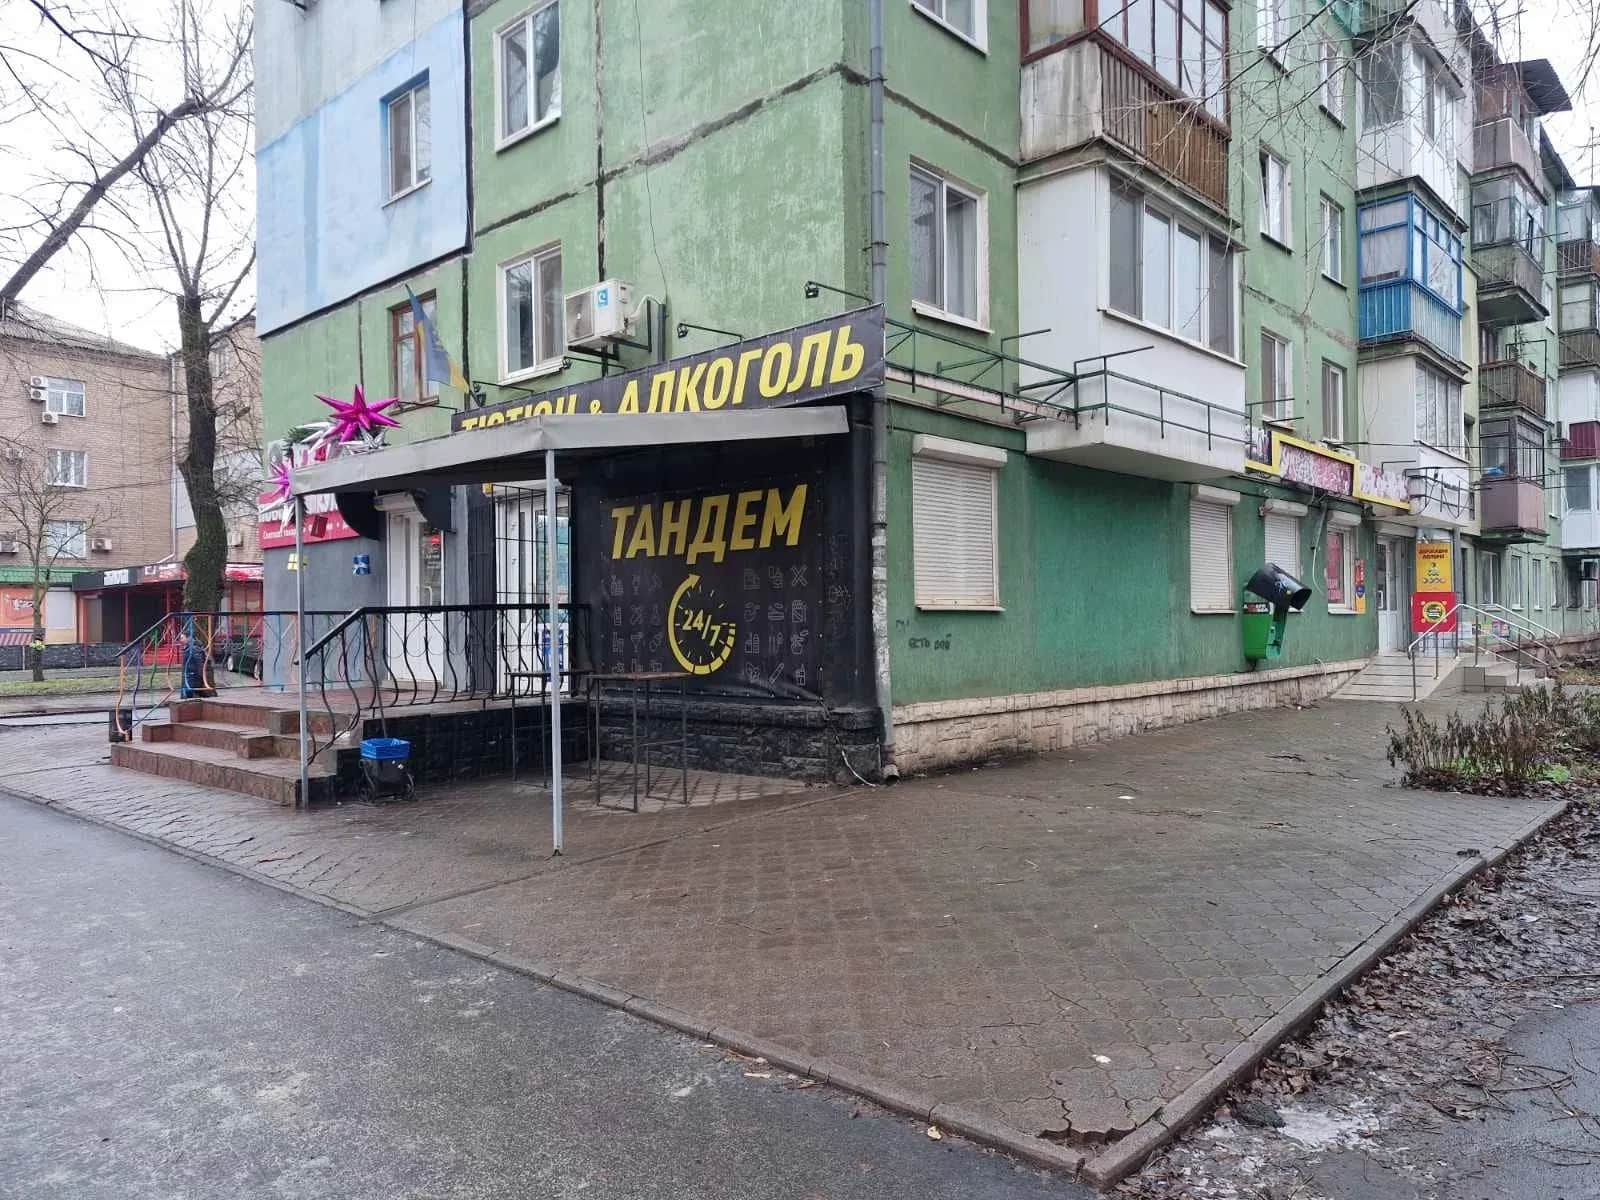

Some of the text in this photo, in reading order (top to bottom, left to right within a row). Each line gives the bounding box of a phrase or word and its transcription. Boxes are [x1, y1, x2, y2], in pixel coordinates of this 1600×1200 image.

[618, 326, 866, 415] АЛКОГОЛЬ
[611, 484, 807, 565] ТАНДЕМ
[681, 607, 722, 650] 24/7
